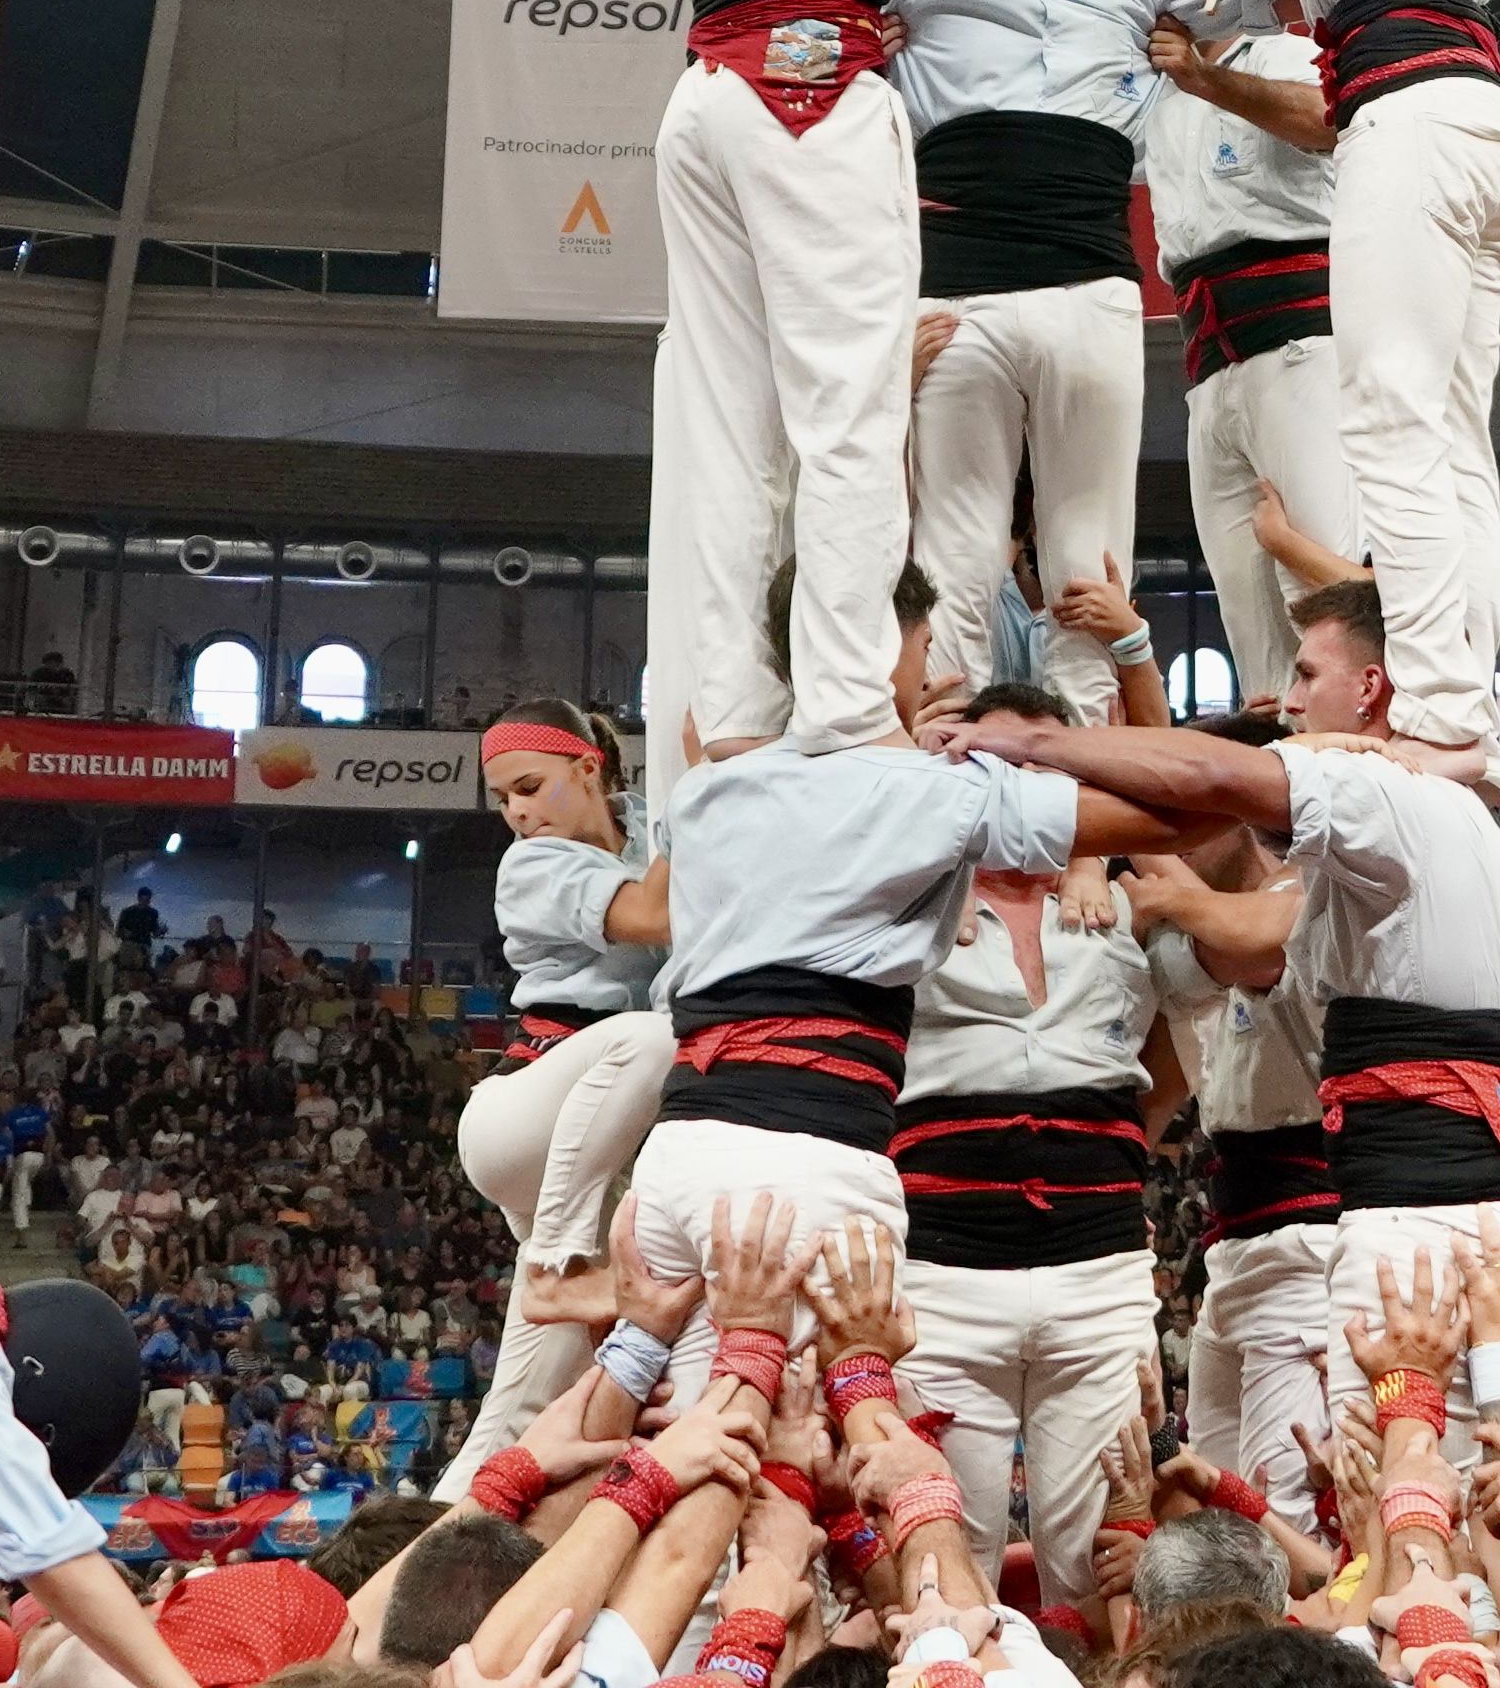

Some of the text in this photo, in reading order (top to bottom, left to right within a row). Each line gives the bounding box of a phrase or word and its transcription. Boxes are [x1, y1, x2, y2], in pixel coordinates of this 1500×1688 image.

[483, 135, 656, 162] Patrocinador princ
[558, 237, 612, 246] CONCURS
[27, 753, 230, 780] ESTRELLA DAMM
[334, 753, 463, 788] repsol
